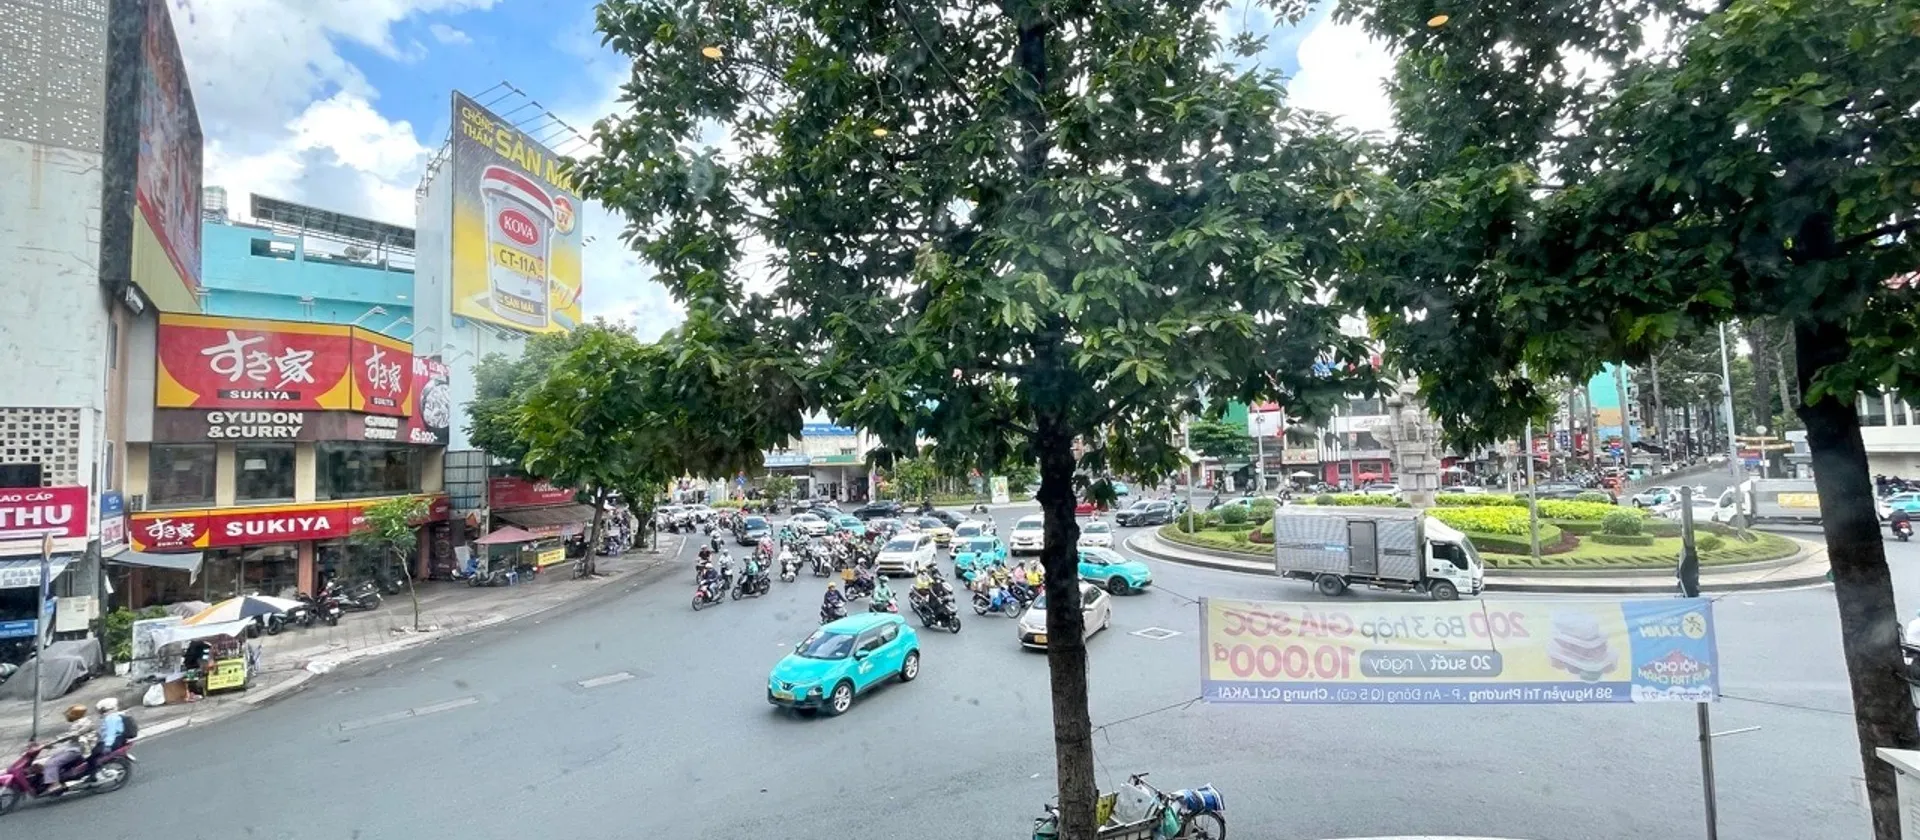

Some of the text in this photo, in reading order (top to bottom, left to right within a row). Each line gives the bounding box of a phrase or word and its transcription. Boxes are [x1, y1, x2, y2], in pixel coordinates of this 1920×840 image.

[462, 106, 494, 133] CHỐNG
[503, 216, 534, 240] KOVA
[499, 249, 537, 276] CT-11A
[201, 330, 315, 389] すき家
[365, 344, 401, 397] すき家
[229, 390, 290, 400] SUKIYA
[207, 411, 304, 424] GYUDON
[207, 425, 303, 438] &CURRY
[0, 492, 54, 502] AO CẤP
[0, 504, 72, 528] THU
[226, 516, 331, 537] SUKIYA
[145, 518, 195, 541] すき家
